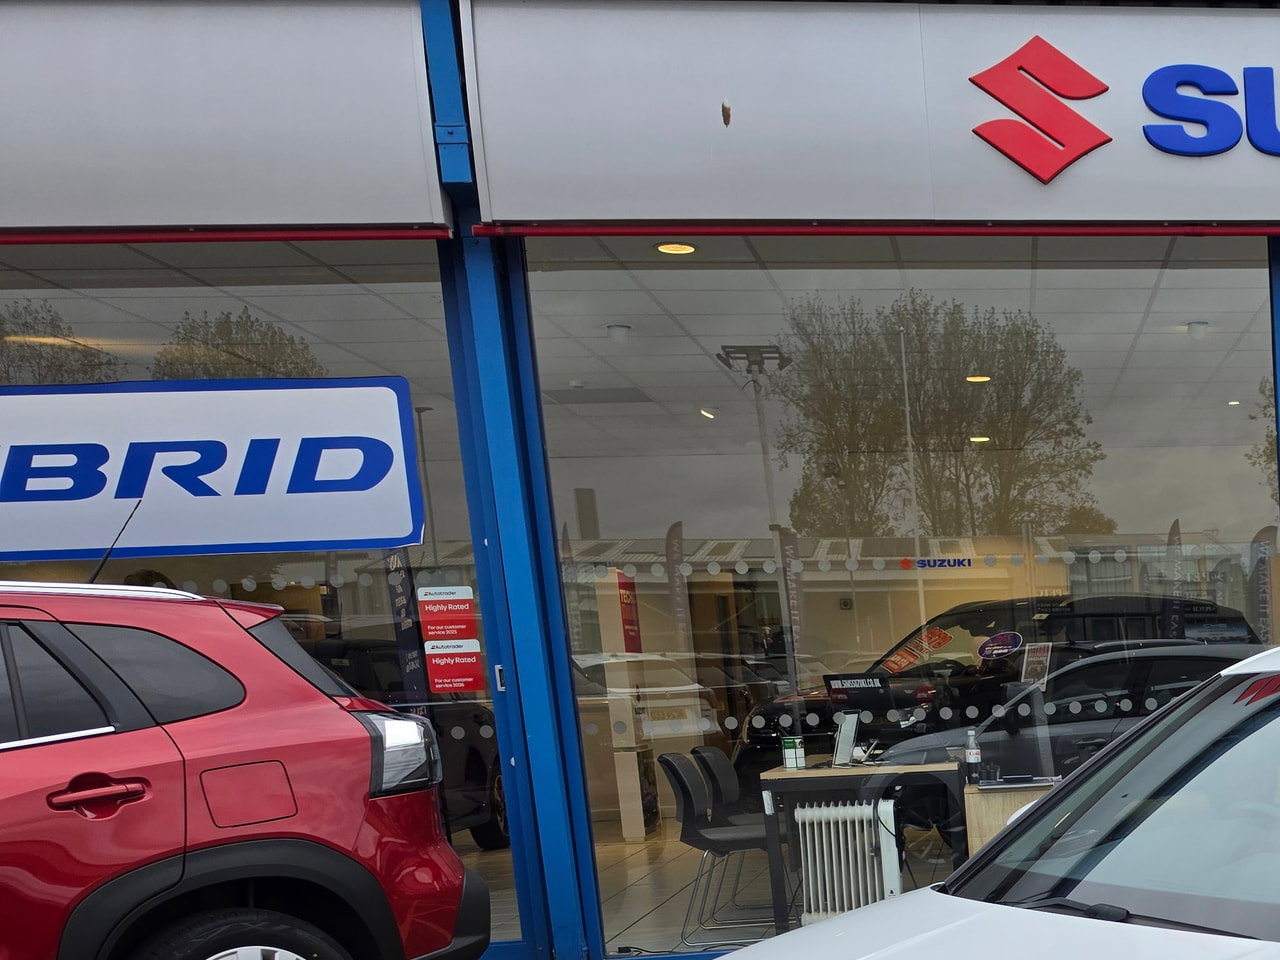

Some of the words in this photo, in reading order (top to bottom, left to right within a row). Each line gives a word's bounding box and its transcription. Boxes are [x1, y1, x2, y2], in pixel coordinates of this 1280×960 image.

[916, 558, 972, 568] SUZUKI
[425, 604, 447, 612] Highly
[432, 657, 454, 665] Highly
